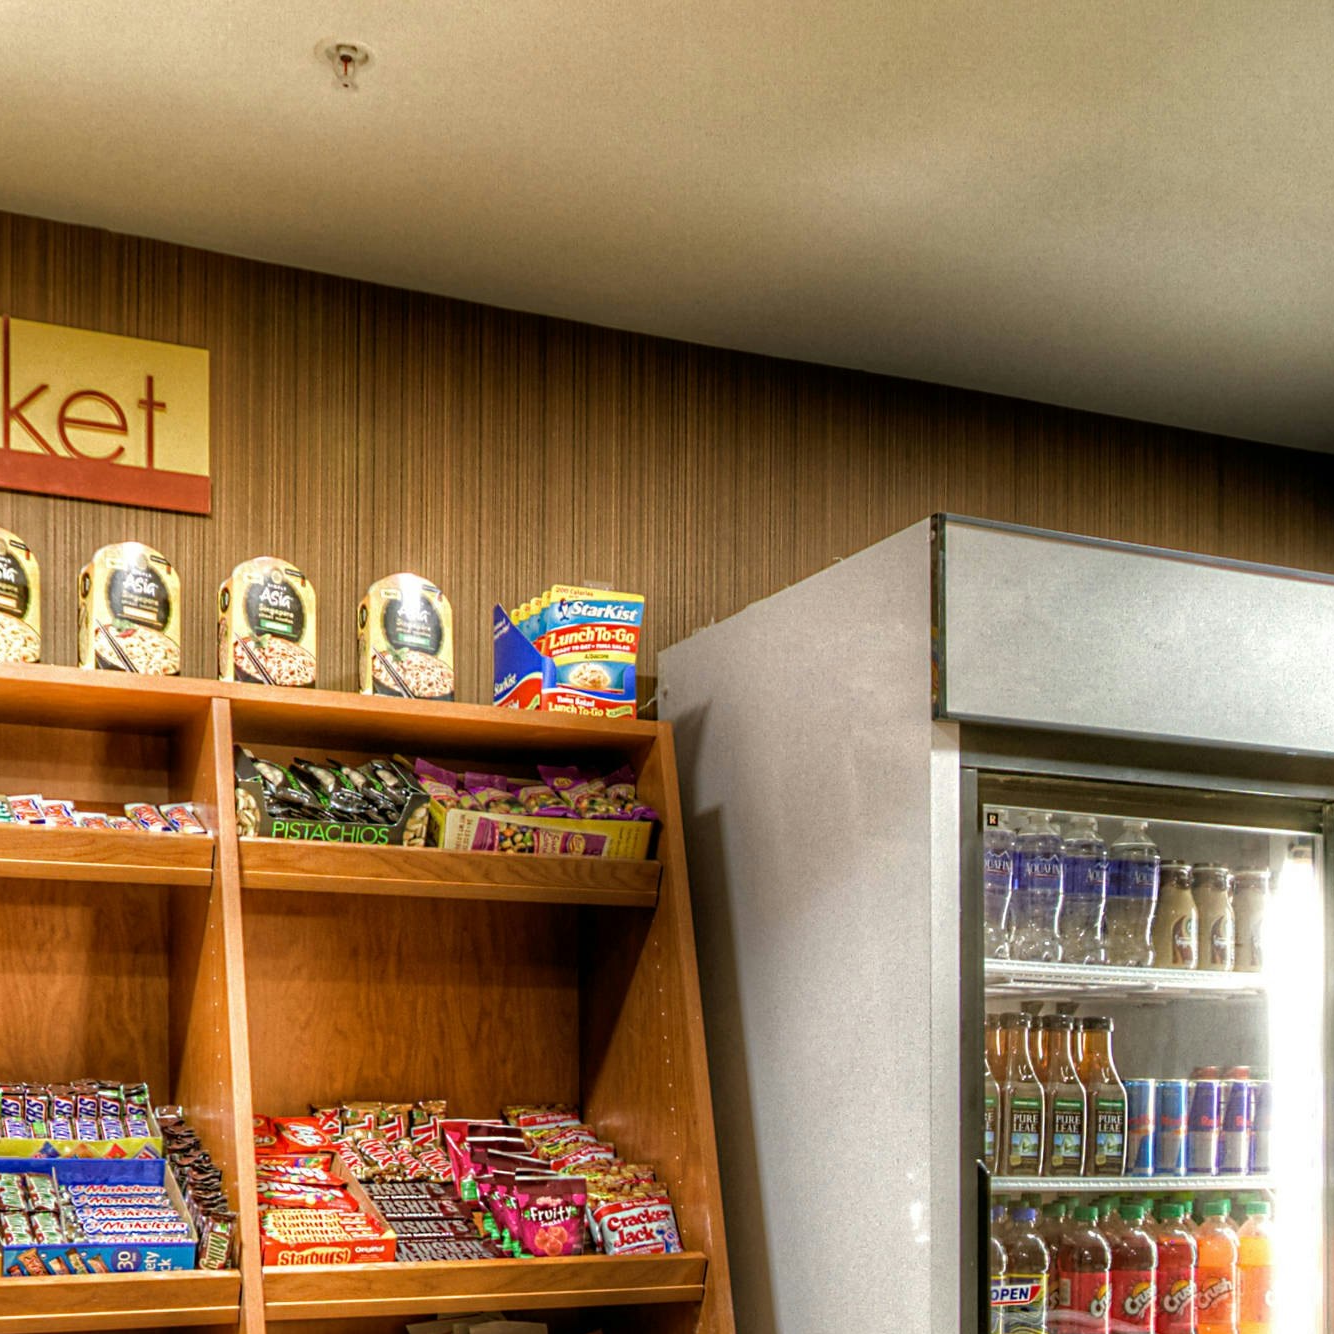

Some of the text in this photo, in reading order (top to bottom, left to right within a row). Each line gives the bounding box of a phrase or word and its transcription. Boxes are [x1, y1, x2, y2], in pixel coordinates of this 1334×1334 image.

[123, 574, 159, 597] Asia
[259, 587, 294, 609] Asia
[571, 601, 638, 622] StarKist
[271, 820, 389, 845] PISTACHIOS
[1026, 862, 1061, 874] AQUAFIN
[1013, 1114, 1039, 1124] PURE
[1055, 1114, 1081, 1124] PURE
[1098, 1114, 1123, 1124] PURE
[1013, 1124, 1039, 1133] LEAF
[1055, 1124, 1081, 1133] LEAF
[1098, 1124, 1123, 1133] LEAF
[367, 1182, 446, 1196] ERSHEY'S
[394, 1220, 468, 1234] RSHEY'S
[607, 1209, 670, 1231] Cracker
[614, 1227, 655, 1248] Jack
[278, 1249, 351, 1265] Starburst
[991, 1286, 1029, 1301] OPEN
